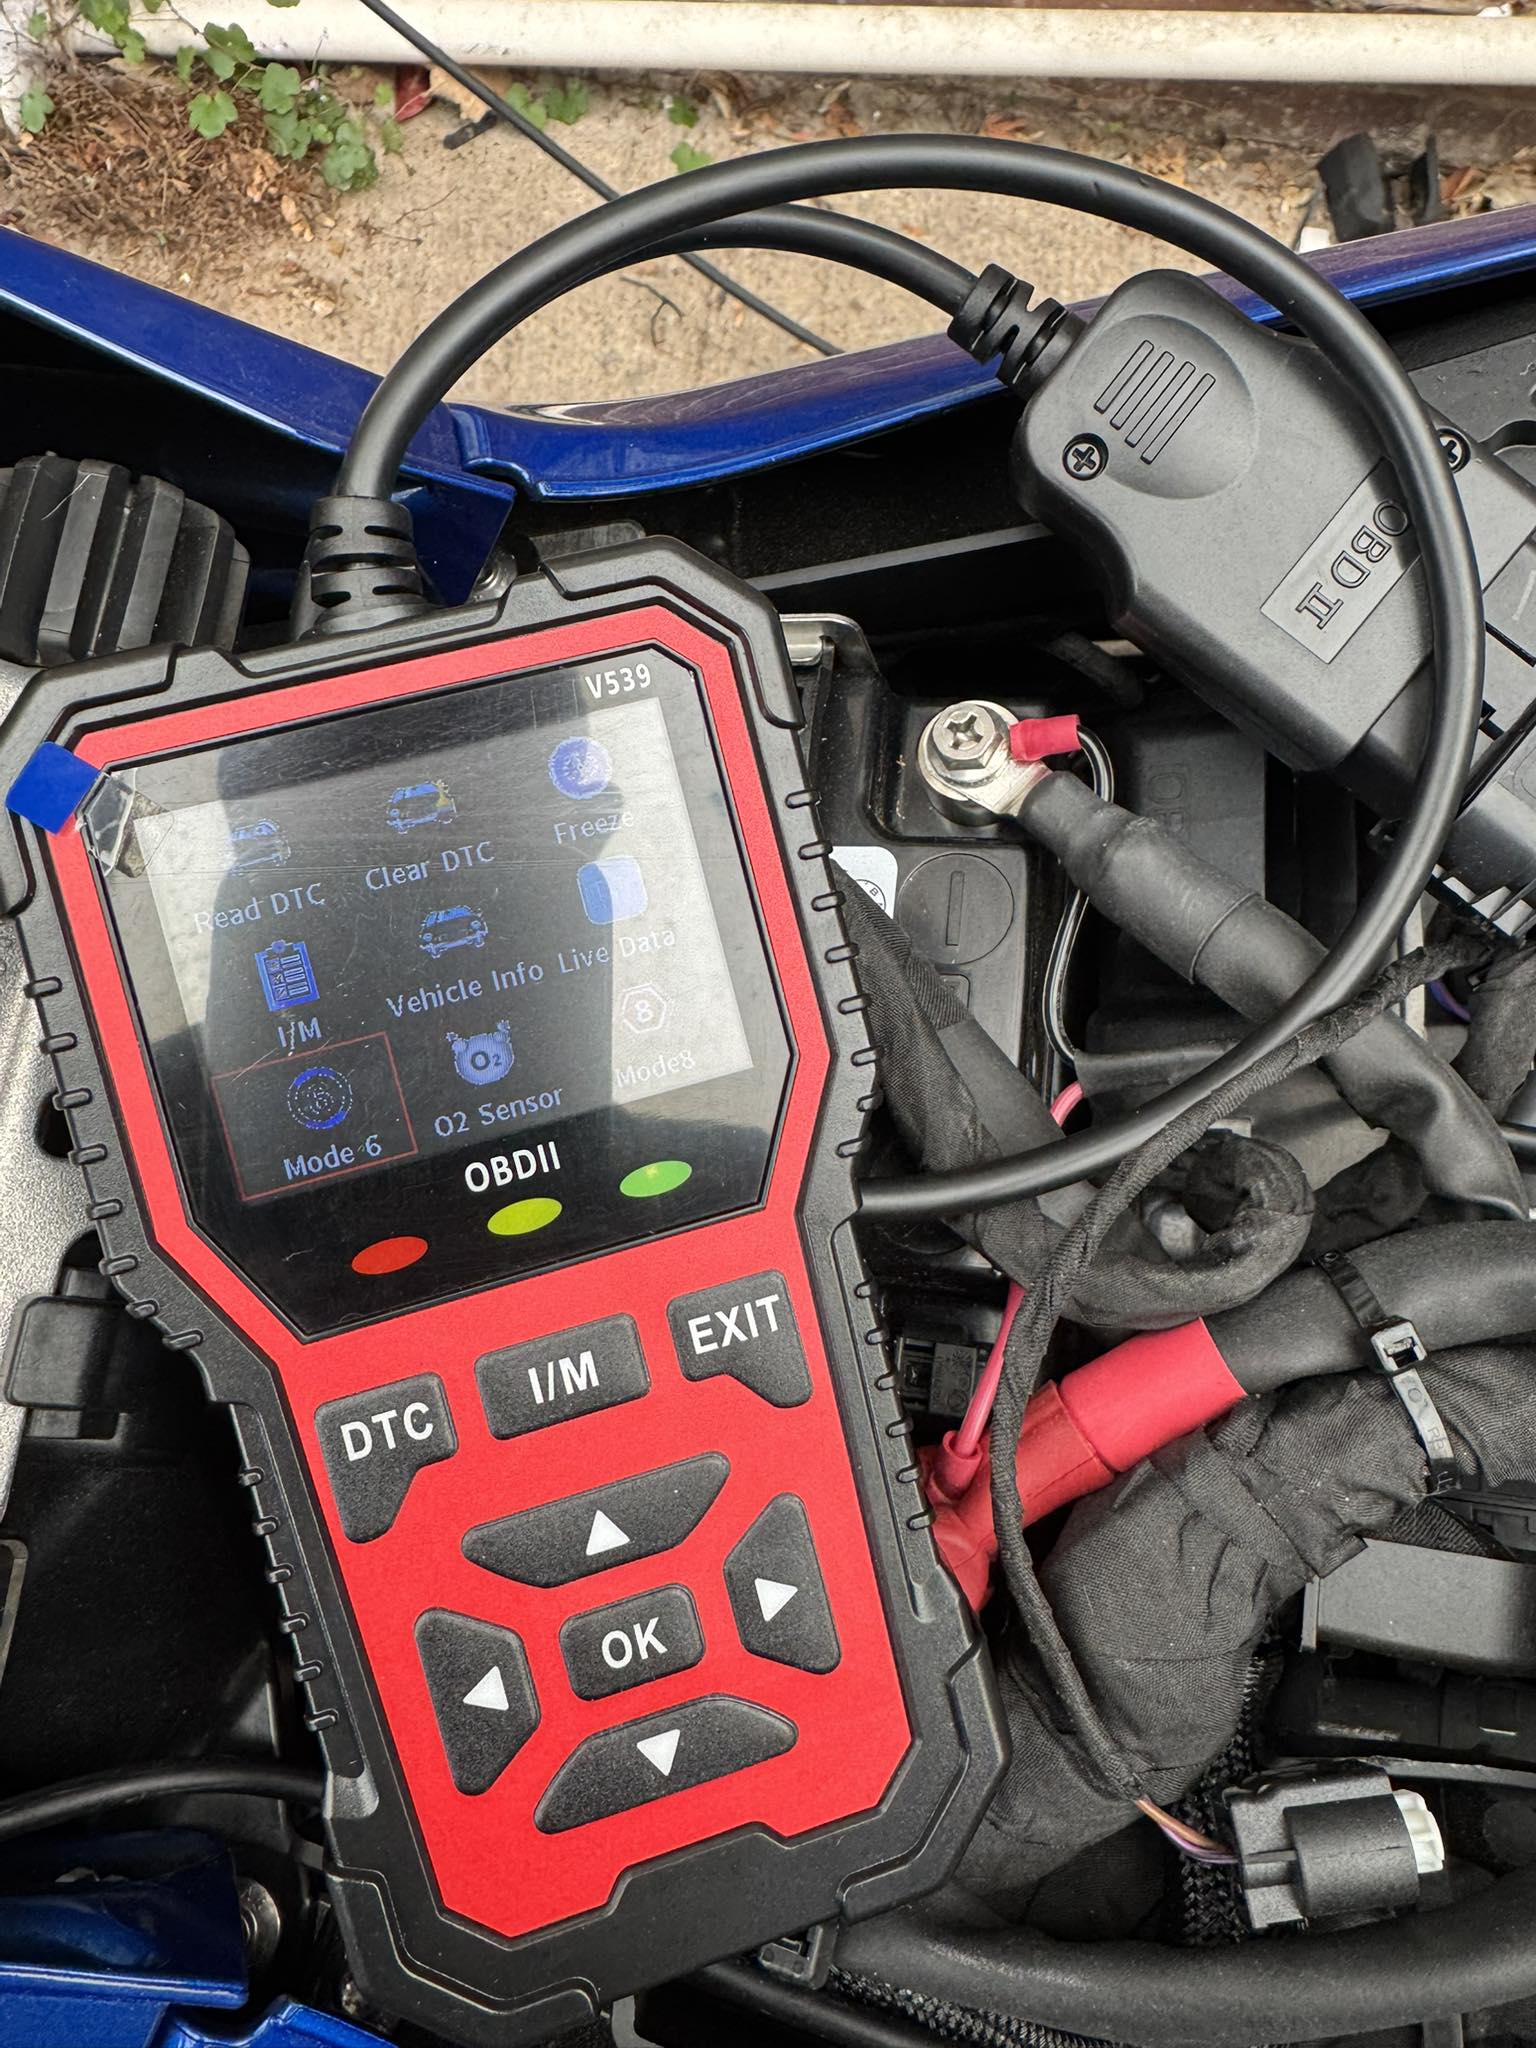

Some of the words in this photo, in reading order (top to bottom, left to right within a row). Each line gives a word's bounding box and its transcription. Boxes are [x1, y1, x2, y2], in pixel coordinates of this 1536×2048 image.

[1331, 500, 1409, 589] OBD
[585, 663, 651, 699] V539
[554, 811, 634, 844] Freeze
[365, 860, 429, 891] Clear
[441, 841, 496, 873] DTC
[193, 896, 261, 934] Read
[270, 882, 326, 916] DTC
[558, 946, 610, 974] Live
[619, 929, 676, 958] Data
[386, 979, 484, 1018] Vehicle
[491, 962, 545, 992] Info
[278, 1017, 322, 1049] I/M
[434, 1110, 470, 1137] O2
[478, 1087, 563, 1127] Sensor
[283, 1143, 355, 1180] Mode
[365, 1134, 382, 1157] 6
[464, 1141, 561, 1193] OBDII
[688, 1294, 780, 1355] EXIT
[527, 1350, 601, 1405] I/M
[340, 1401, 434, 1462] DTC
[601, 1616, 667, 1669] OK
